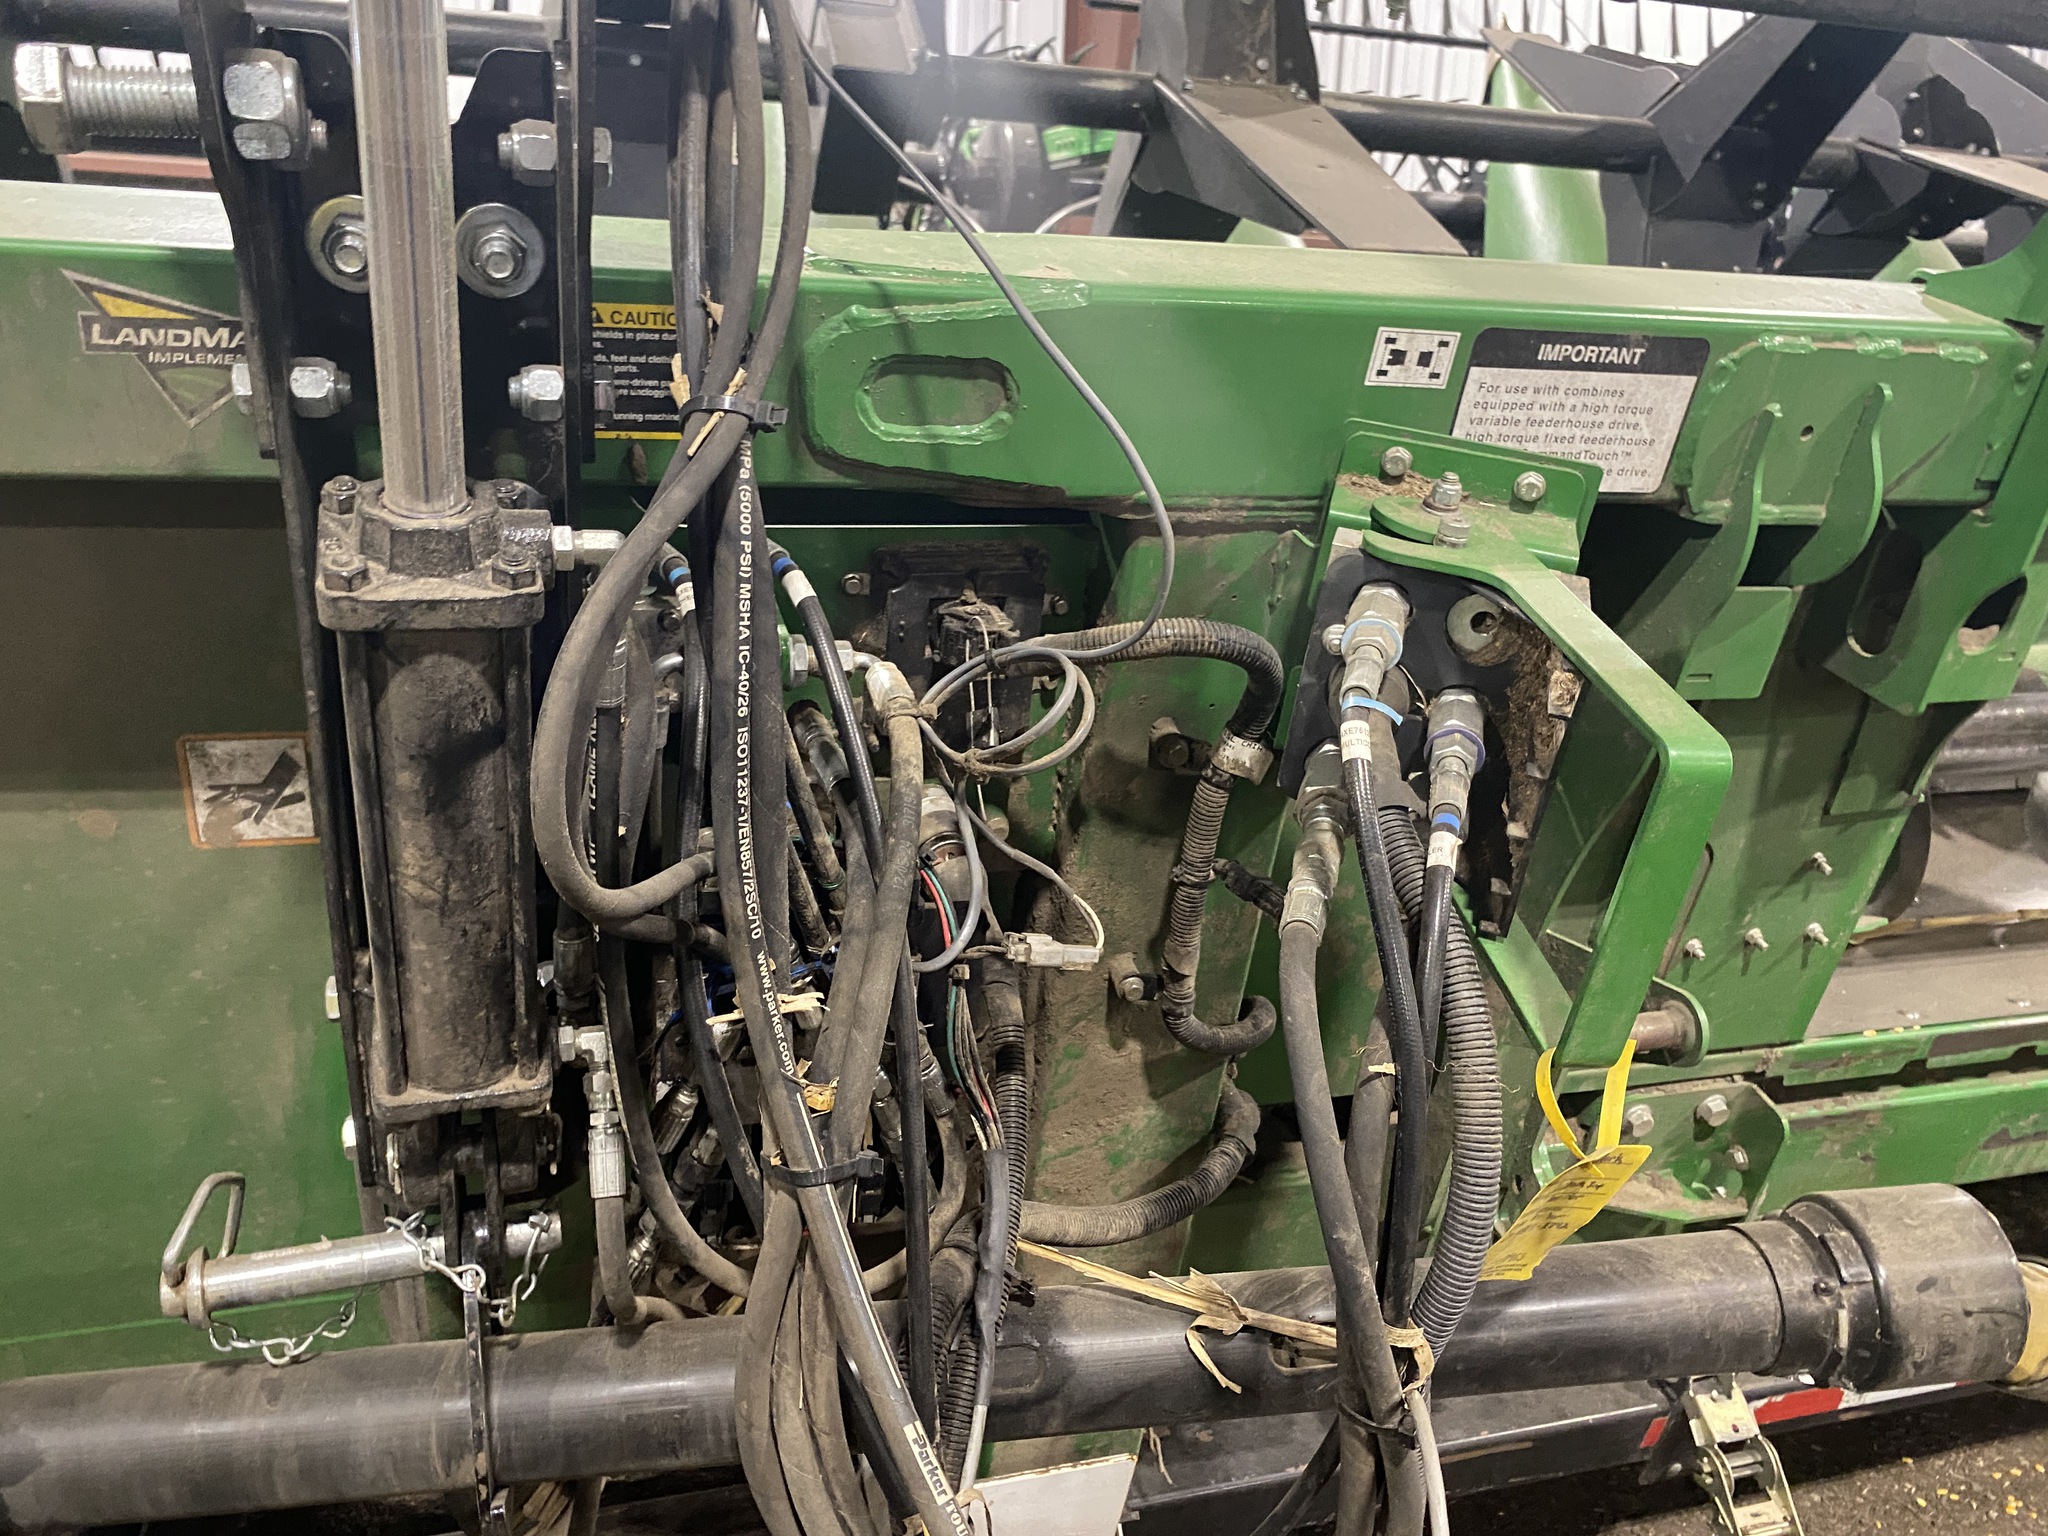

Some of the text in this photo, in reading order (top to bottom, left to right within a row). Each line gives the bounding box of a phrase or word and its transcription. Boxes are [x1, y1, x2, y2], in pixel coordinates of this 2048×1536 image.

[625, 331, 634, 339] in
[635, 332, 660, 341] place
[148, 351, 241, 365] IMPLEME
[610, 354, 628, 363] feet
[629, 354, 647, 363] and
[1537, 343, 1646, 365] IMPORTANT
[1478, 382, 1625, 398] For use with combines
[1473, 400, 1653, 417] equipped with a high torque
[1469, 415, 1521, 427] variable
[1525, 417, 1604, 430] feederhouse
[1497, 433, 1539, 445] torque
[1544, 433, 1575, 445] fixed
[1579, 434, 1656, 447] feederhouse
[1616, 467, 1651, 478] drive.
[736, 439, 796, 1076] MPa (5000 PSI) MSHA IC-40/26 ISO11237-1/EN857/2SC/10 www.parker.com
[911, 1428, 970, 1536] Parker TOU
